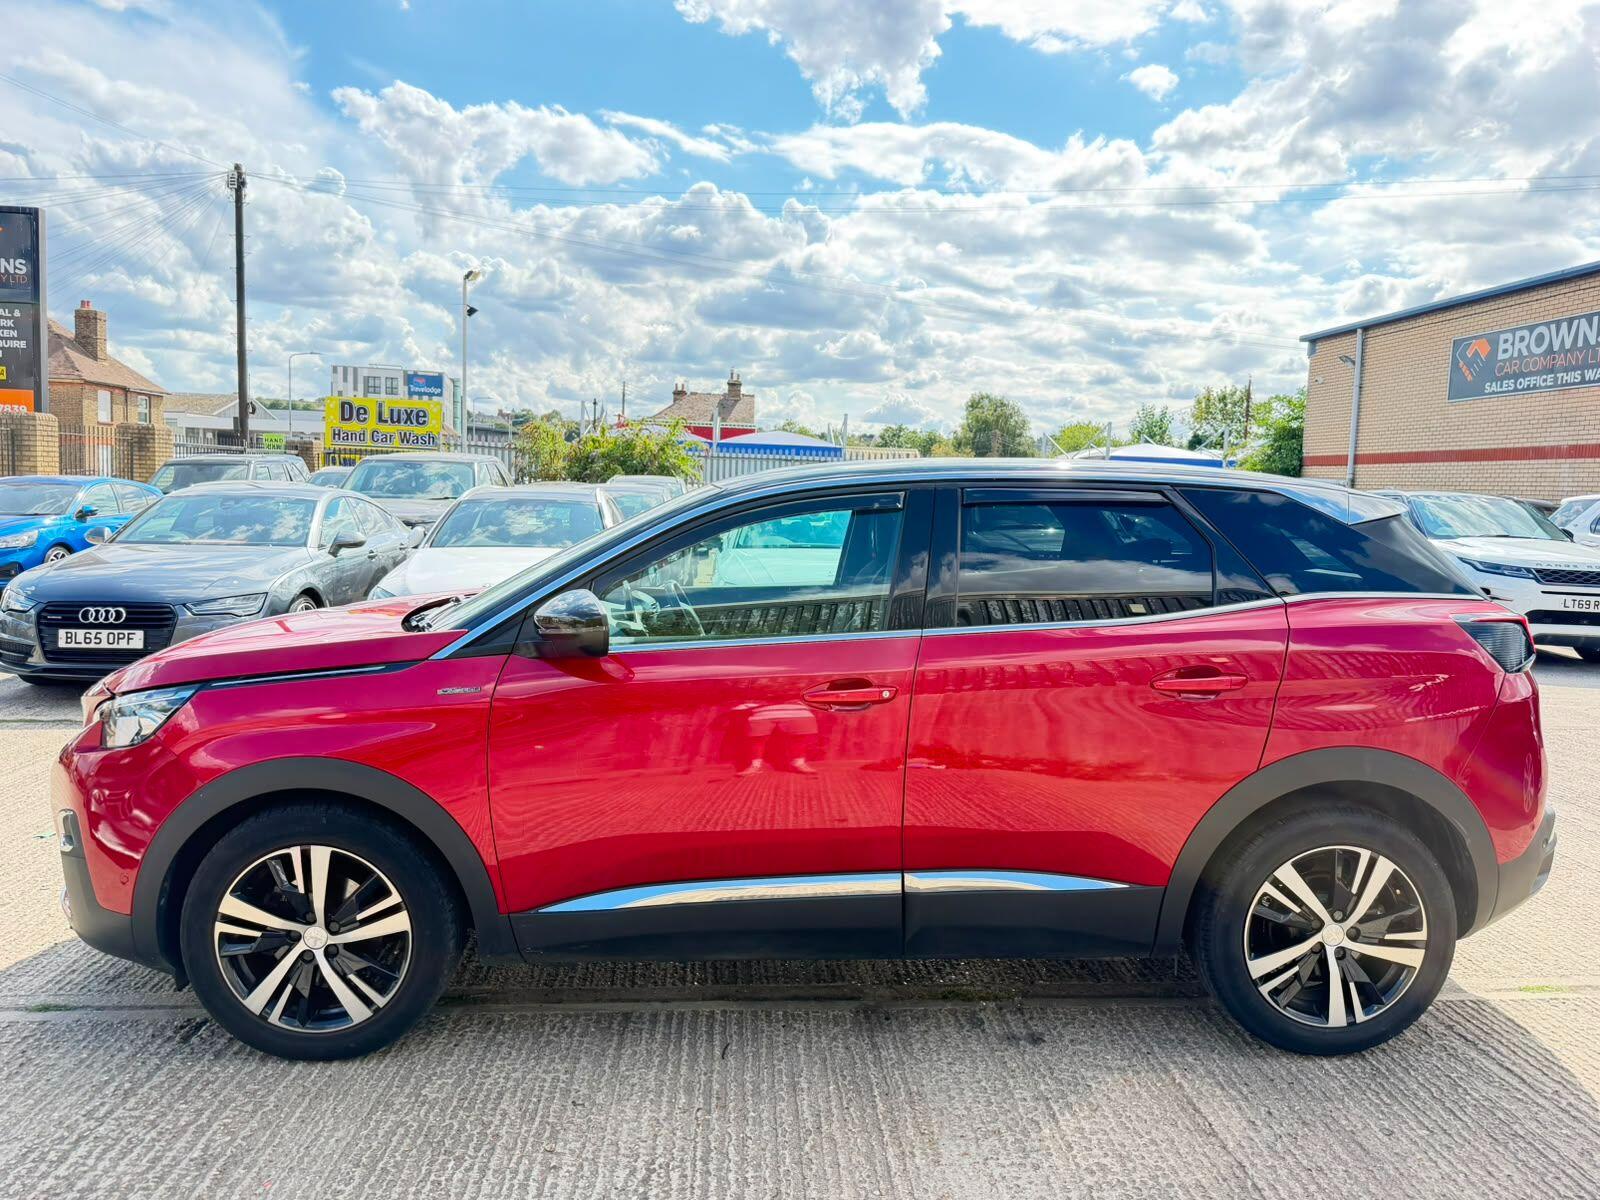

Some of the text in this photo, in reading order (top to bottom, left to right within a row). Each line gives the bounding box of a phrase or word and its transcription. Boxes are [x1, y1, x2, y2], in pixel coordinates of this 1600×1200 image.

[10, 274, 28, 284] LTD
[1497, 315, 1600, 361] BROWN
[1495, 360, 1519, 377] CAR
[1522, 350, 1586, 374] COMPANY
[1484, 379, 1515, 394] SALES
[1516, 373, 1554, 390] OFFICE
[1556, 370, 1582, 385] THIS
[340, 401, 428, 426] De Luxe
[332, 428, 436, 446] Hand Car Wash
[1563, 598, 1591, 610] LT69
[65, 631, 136, 645] BL65 OPF
